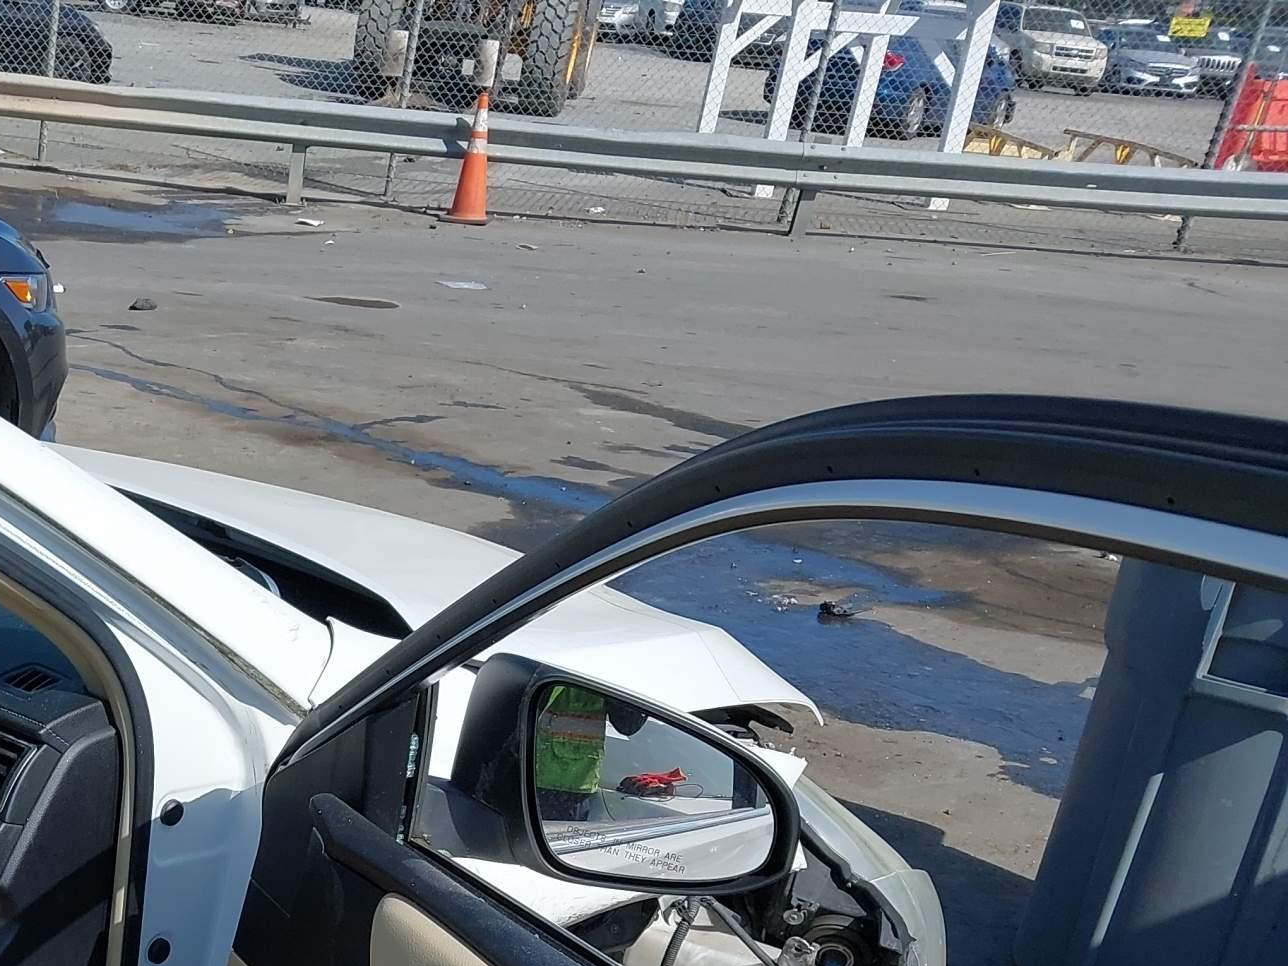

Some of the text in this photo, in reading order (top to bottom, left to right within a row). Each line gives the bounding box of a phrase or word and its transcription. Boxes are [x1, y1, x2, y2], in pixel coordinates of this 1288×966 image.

[624, 851, 647, 864] THEY
[649, 858, 686, 875] APPEAR
[626, 841, 661, 857] MIRROR
[664, 851, 684, 863] ARE
